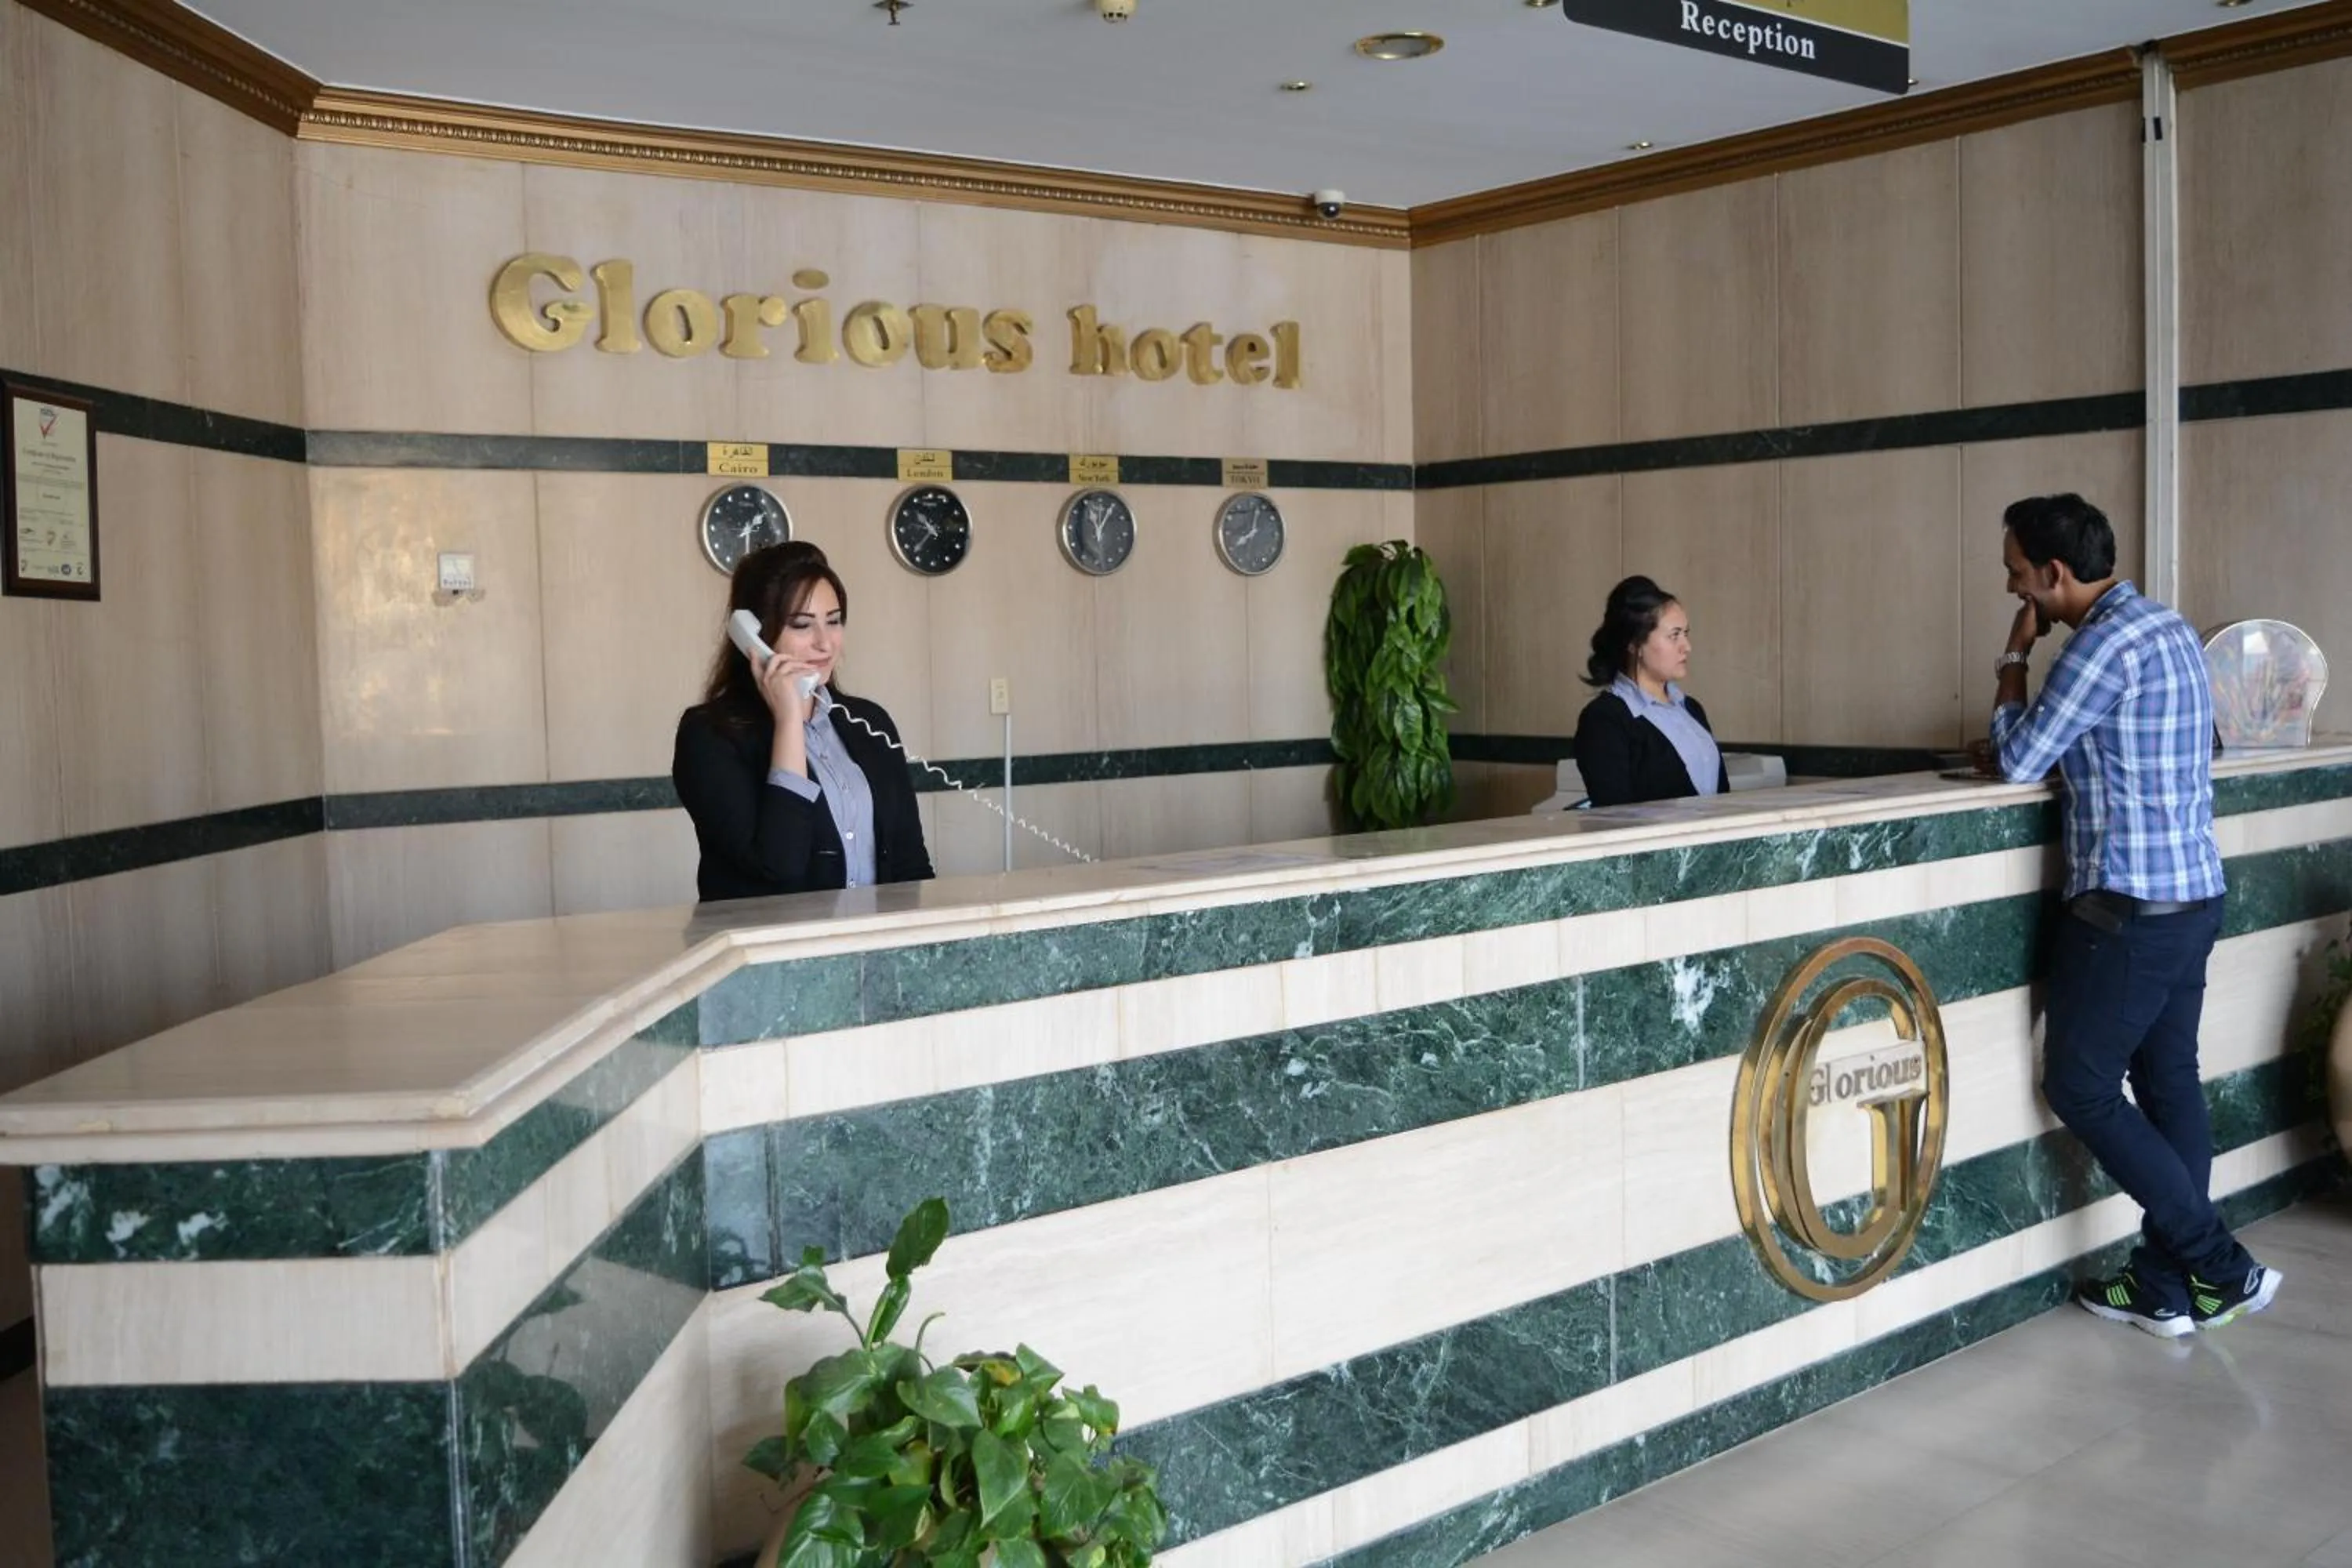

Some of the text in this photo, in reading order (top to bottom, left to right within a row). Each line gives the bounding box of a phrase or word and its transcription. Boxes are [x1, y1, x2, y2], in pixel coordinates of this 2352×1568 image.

[1680, 0, 1817, 60] Reception
[490, 252, 1305, 390] Glorious hotel
[718, 462, 758, 474] Cairo
[906, 468, 944, 477] London
[1809, 1054, 1922, 1107] Glorious
